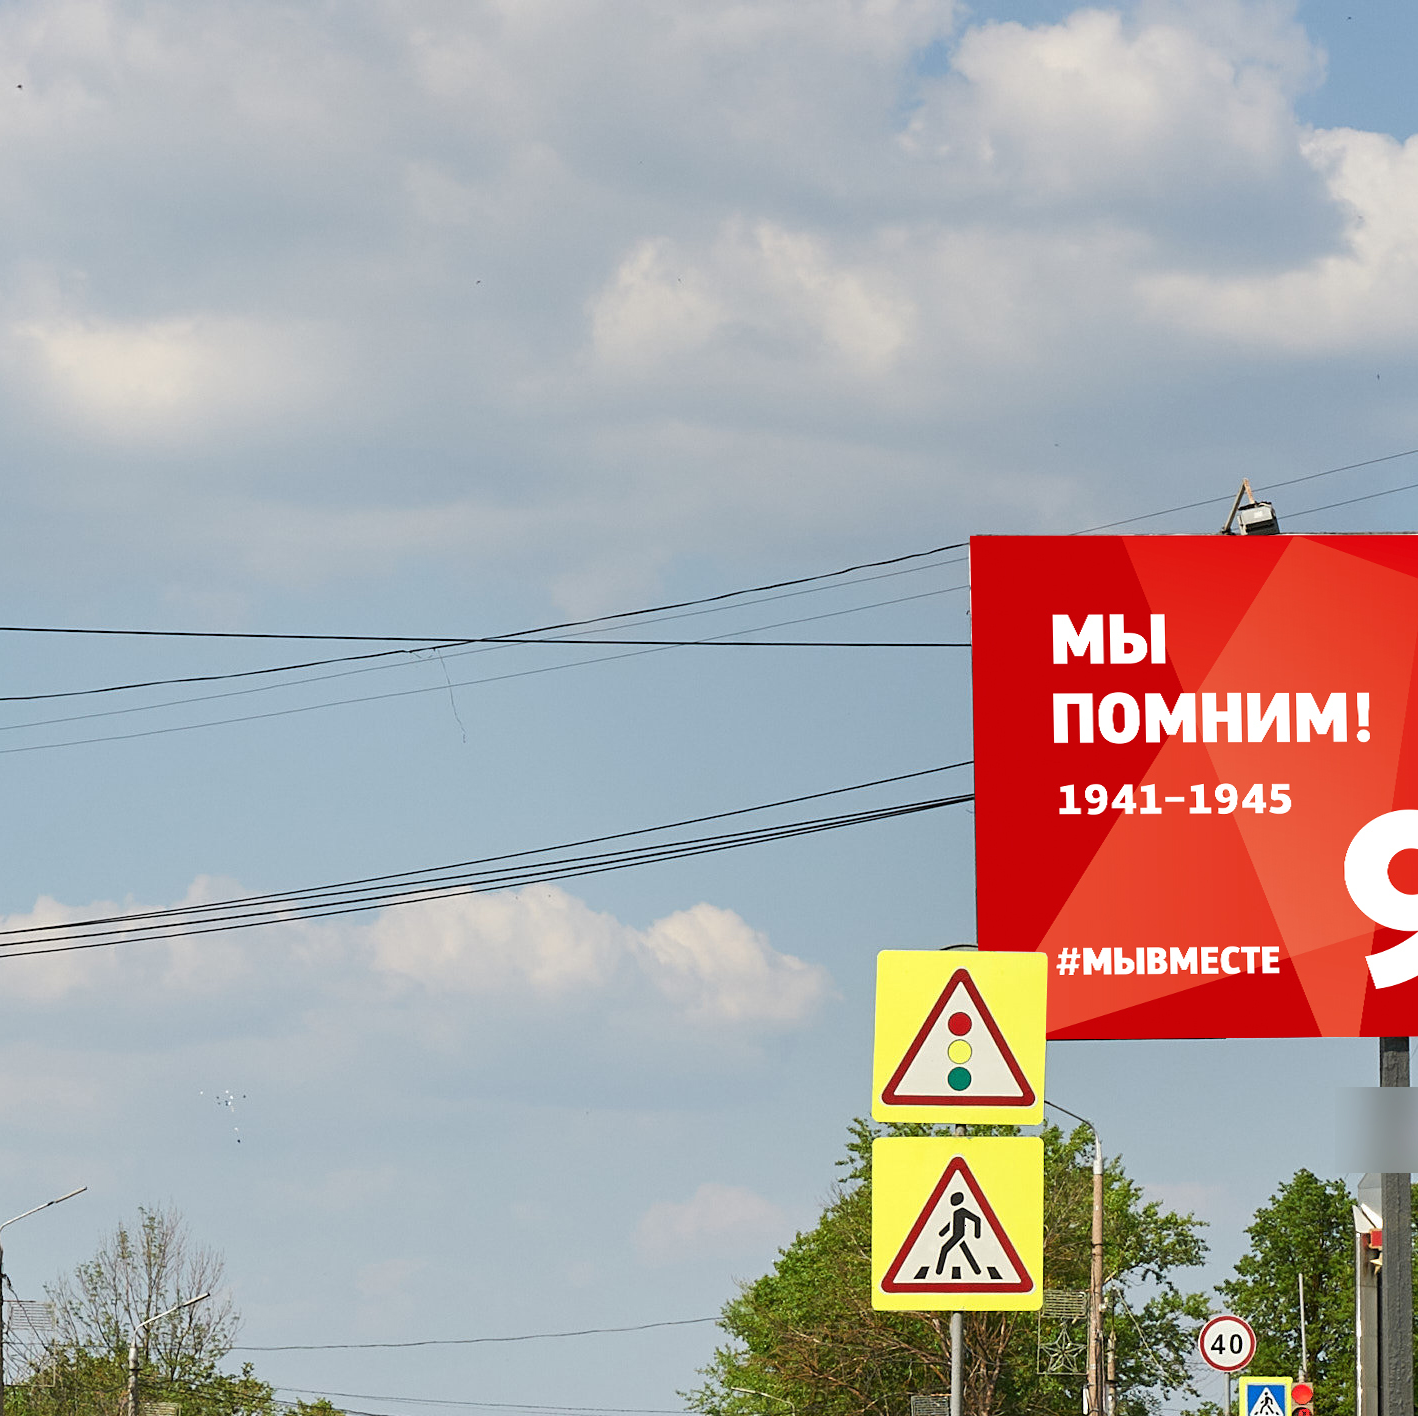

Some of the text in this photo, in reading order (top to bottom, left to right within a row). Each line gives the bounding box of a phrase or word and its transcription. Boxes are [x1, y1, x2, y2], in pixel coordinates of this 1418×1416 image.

[1052, 613, 1166, 665] МЫ
[1052, 691, 1371, 745] ПОМНИМ!
[1056, 944, 1281, 977] #МЫВМЕСТЕ
[1210, 1333, 1243, 1355] 40
